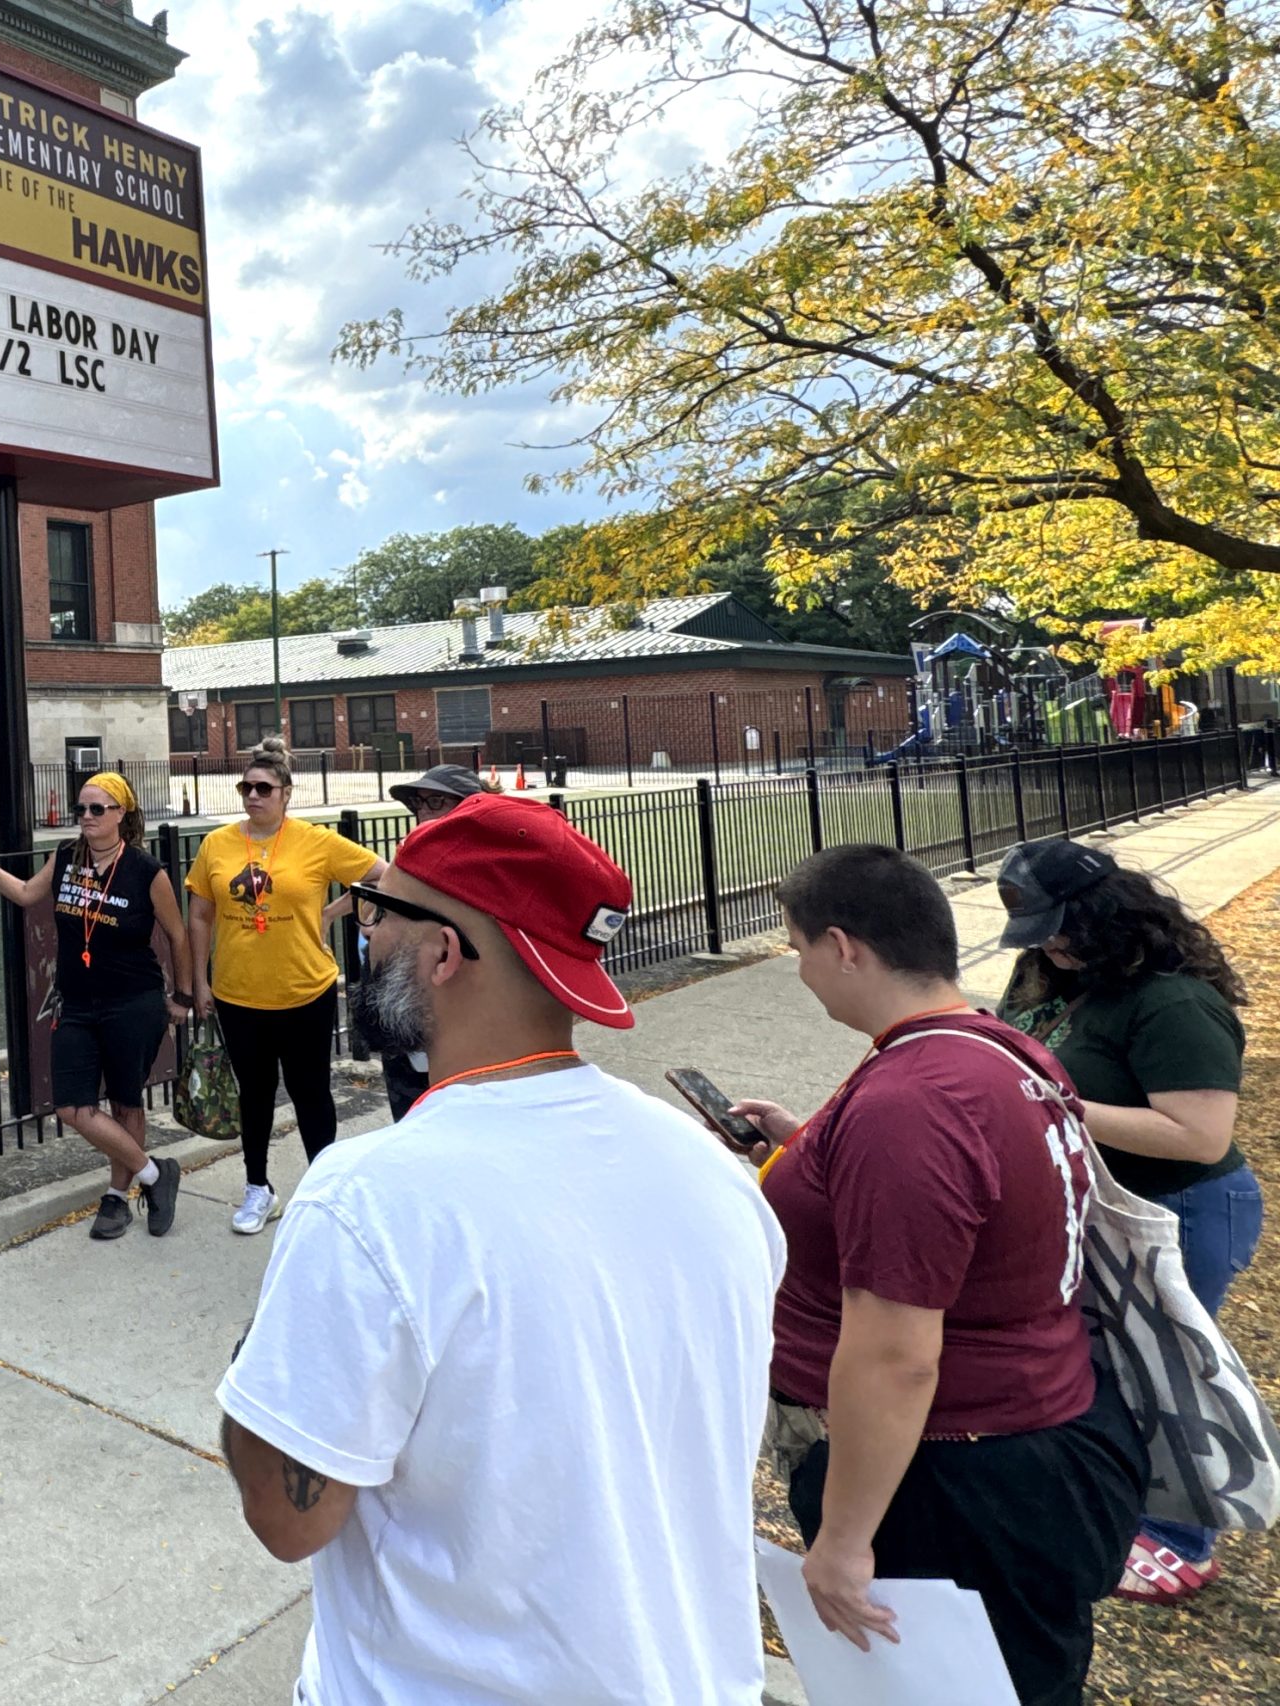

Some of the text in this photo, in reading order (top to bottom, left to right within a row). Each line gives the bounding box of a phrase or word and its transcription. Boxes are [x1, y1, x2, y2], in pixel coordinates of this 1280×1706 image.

[104, 136, 188, 188] HENRY
[22, 177, 41, 200] OF
[47, 185, 76, 214] THE
[115, 170, 185, 220] SCHOOL
[72, 217, 201, 296] HAWKS
[10, 296, 98, 351] LABOR
[113, 323, 160, 365] DAY
[59, 351, 106, 392] LSC
[104, 894, 129, 908] LAND
